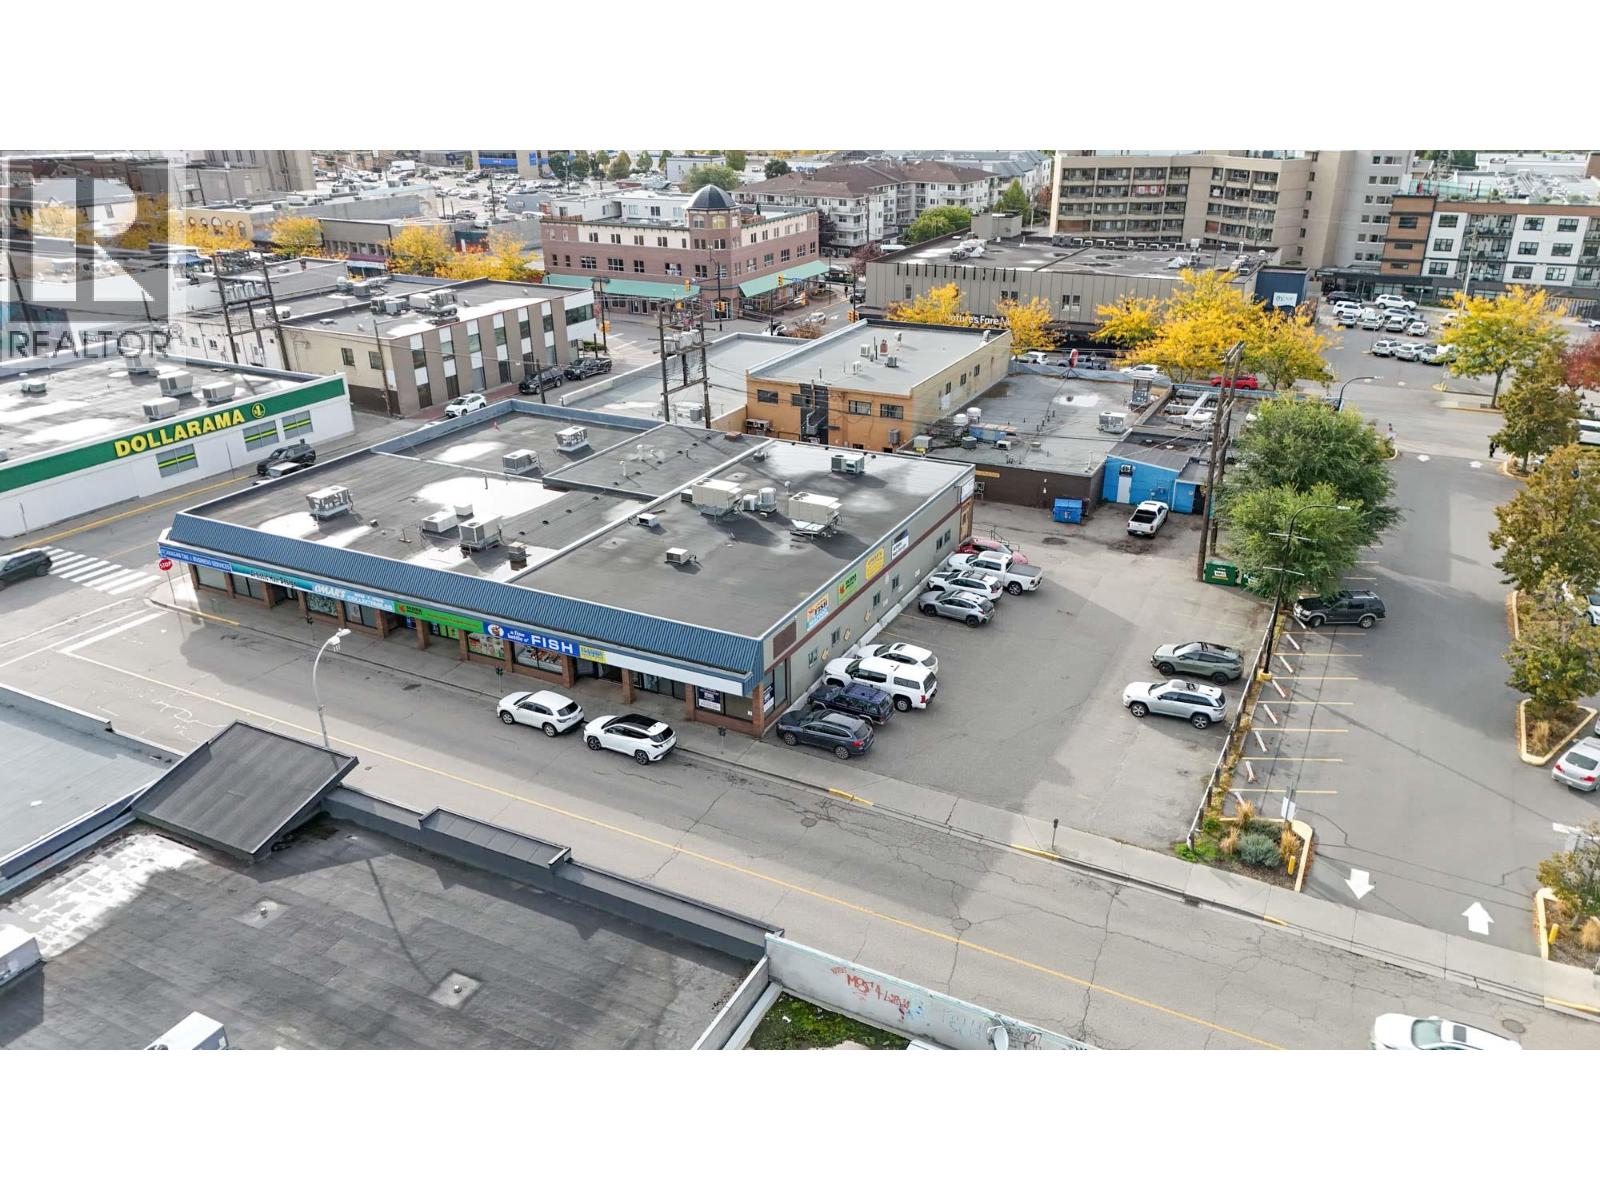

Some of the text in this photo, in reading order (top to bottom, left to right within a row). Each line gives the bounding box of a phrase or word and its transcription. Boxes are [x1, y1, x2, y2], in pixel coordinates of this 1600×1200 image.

[980, 315, 999, 325] Fare
[114, 409, 246, 458] DOLLARAMA
[531, 634, 573, 654] FISH
